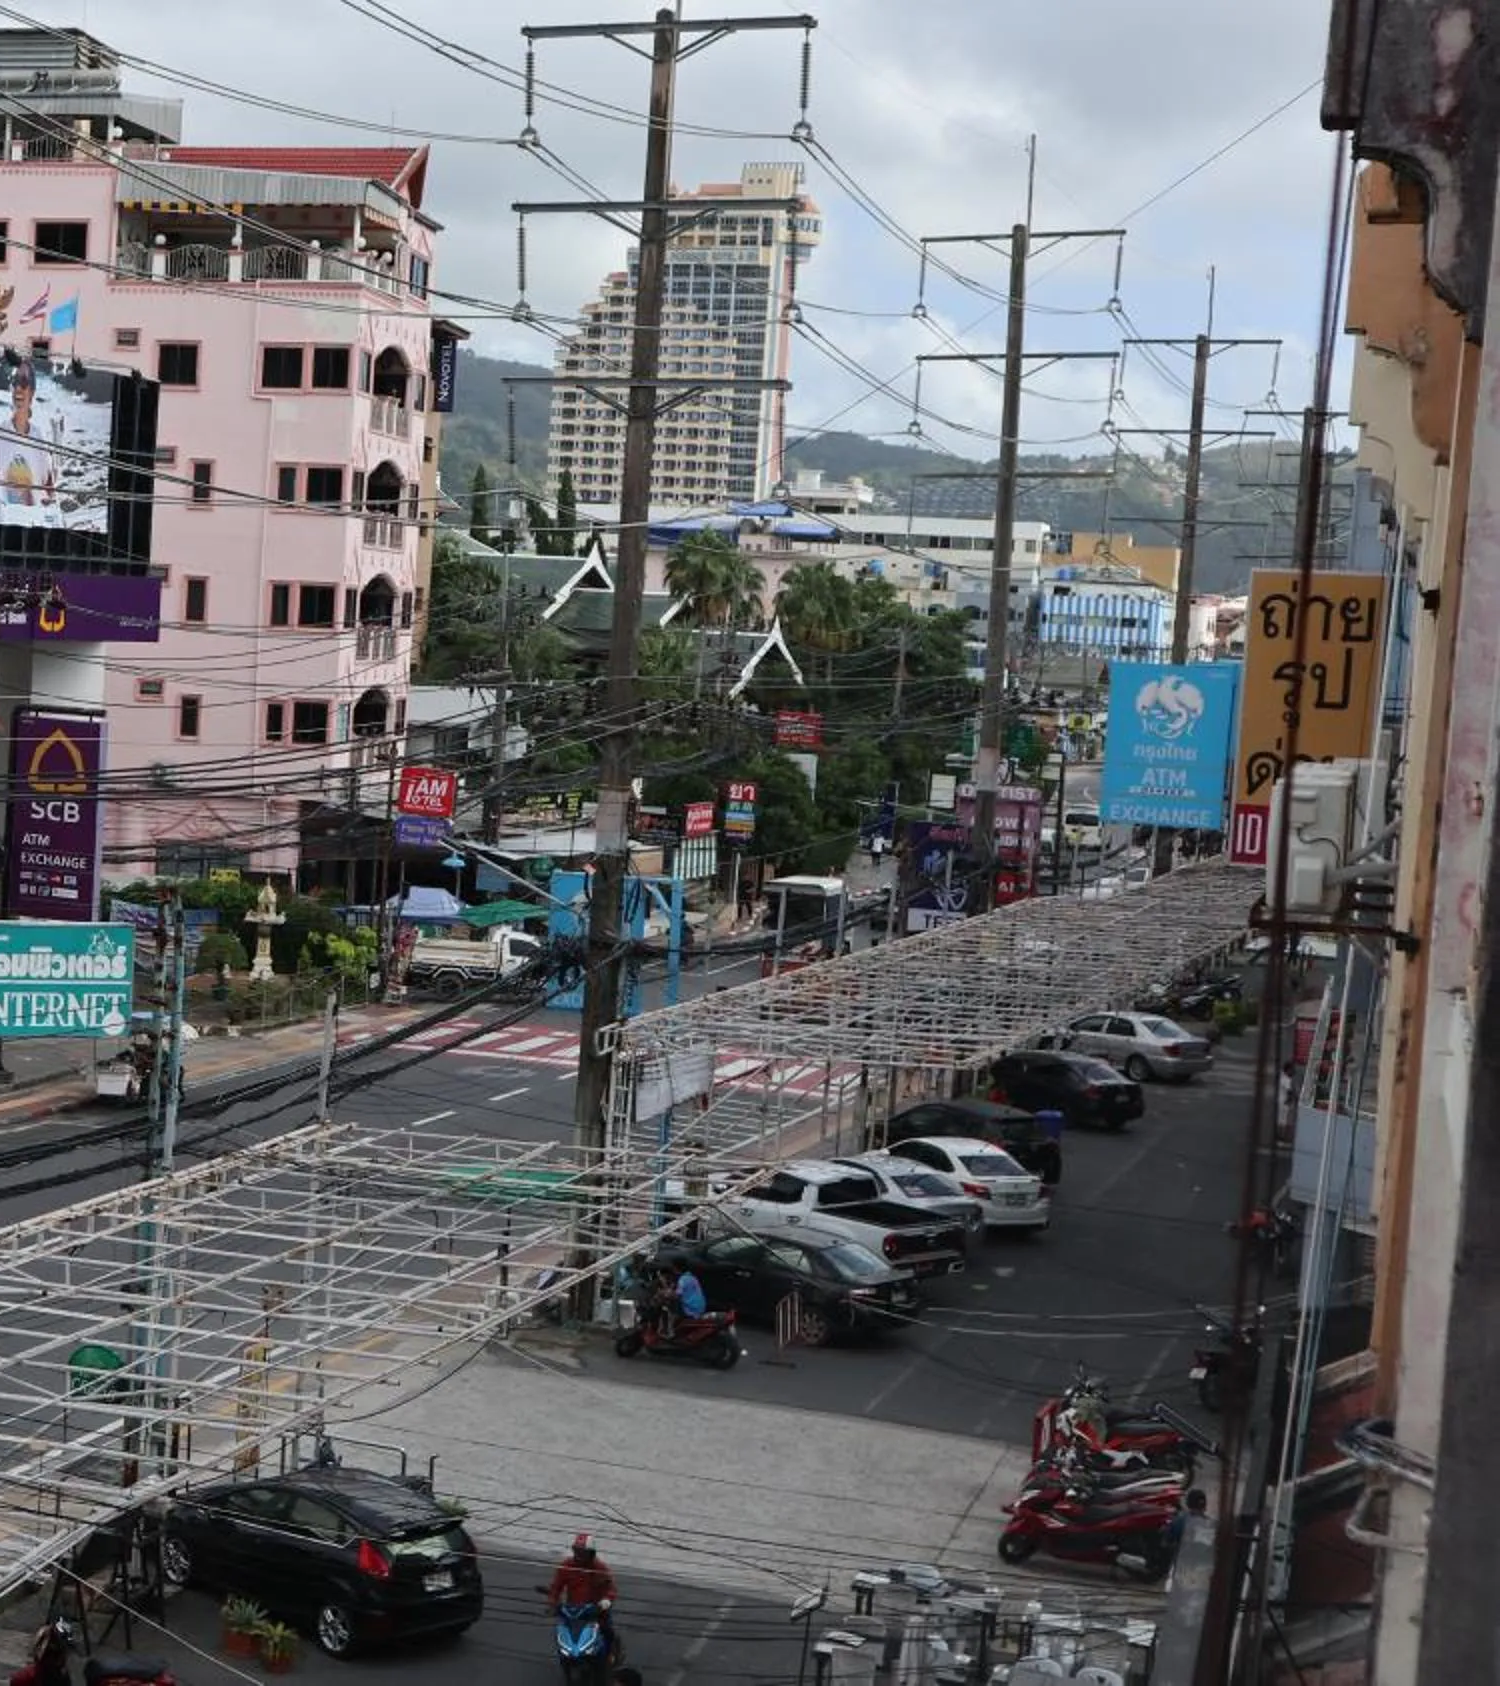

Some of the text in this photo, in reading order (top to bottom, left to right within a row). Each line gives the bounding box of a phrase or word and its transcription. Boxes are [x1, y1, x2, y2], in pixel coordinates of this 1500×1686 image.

[1260, 581, 1377, 642] ถ่าย
[1273, 647, 1353, 729] รูป
[1141, 768, 1187, 787] ATM
[961, 784, 1035, 799] DTIST
[30, 801, 80, 823] SCB
[1110, 804, 1213, 825] EXCHANGE
[21, 832, 51, 847] ATM
[20, 852, 88, 869] EXCHANGE
